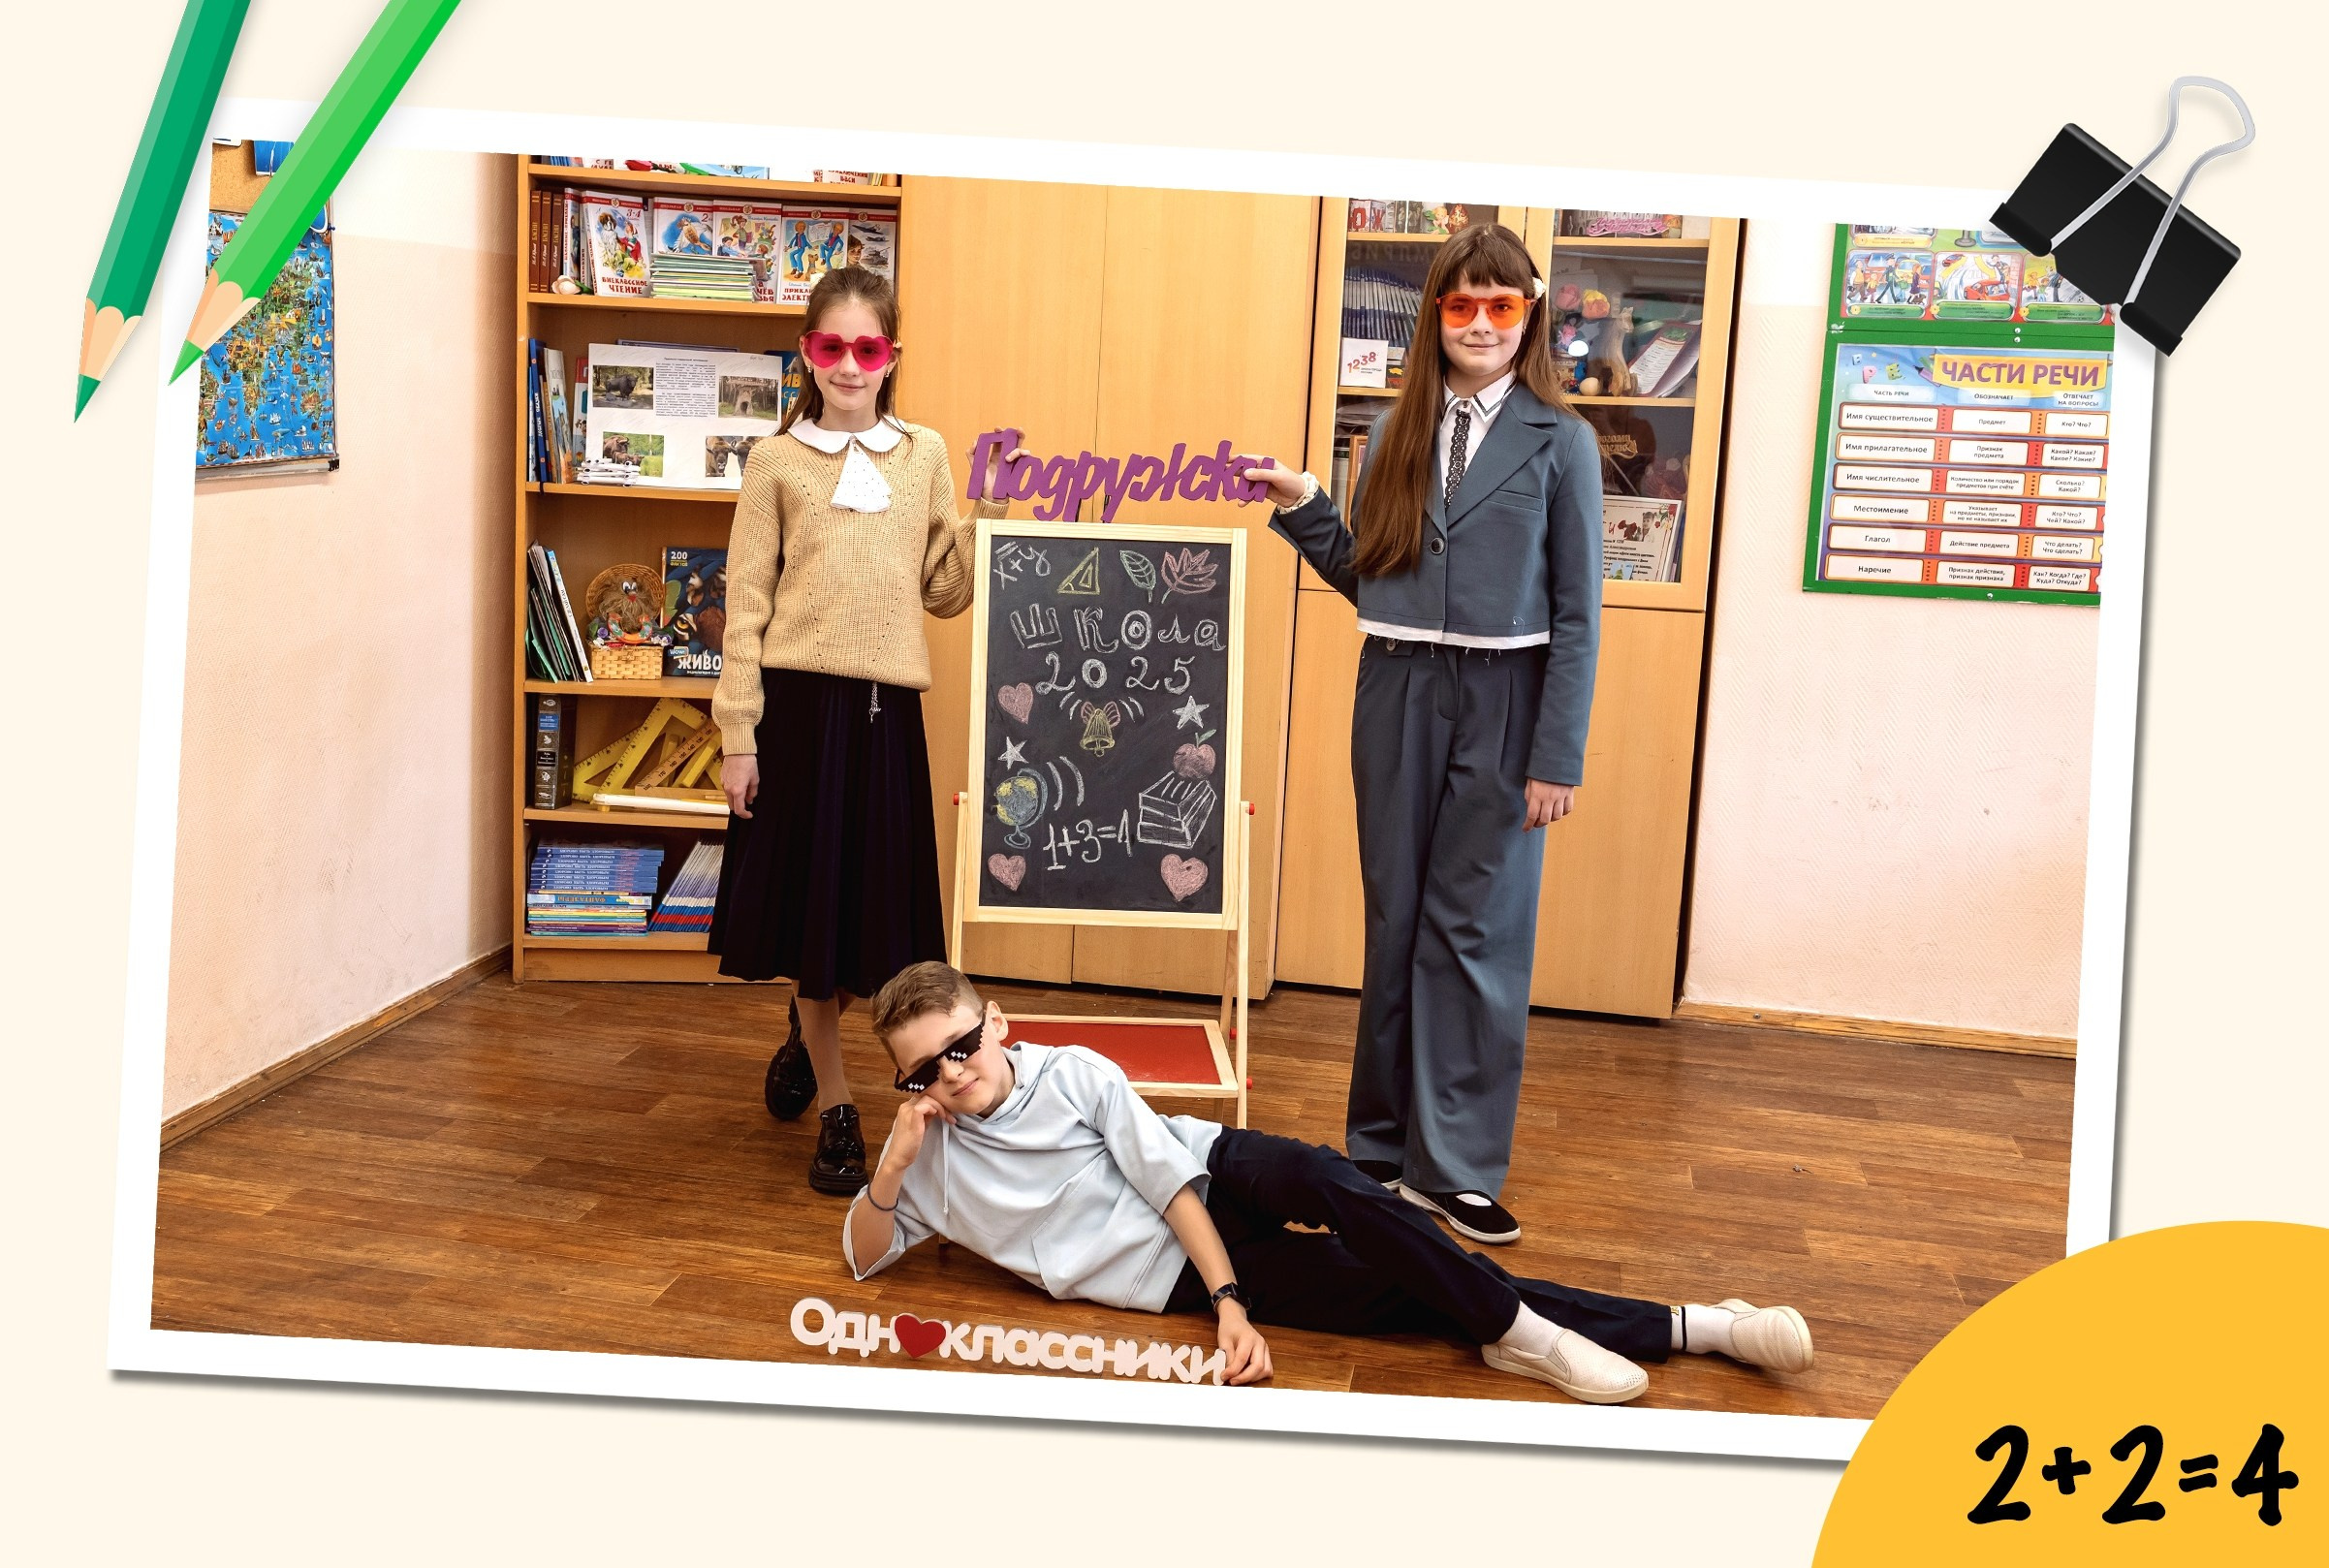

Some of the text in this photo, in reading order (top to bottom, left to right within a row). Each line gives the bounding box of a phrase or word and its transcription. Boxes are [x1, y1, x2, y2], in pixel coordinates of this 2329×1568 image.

[1371, 207, 1386, 231] Ж
[609, 284, 643, 295] ЧТЕНИЕ
[1347, 351, 1377, 373] 1238
[1942, 361, 2099, 387] ЧАСТИ РЕЧИ
[1865, 414, 1934, 423] существительное
[1864, 445, 1928, 454] прилагательное
[1865, 475, 1920, 484] числительное
[1853, 505, 1909, 515] Местоимение
[671, 550, 688, 560] 200
[1858, 565, 1892, 574] Наречие
[677, 653, 722, 671] ЖИВО
[1035, 651, 1196, 695] 2025
[790, 1297, 1227, 1386] Однклассники
